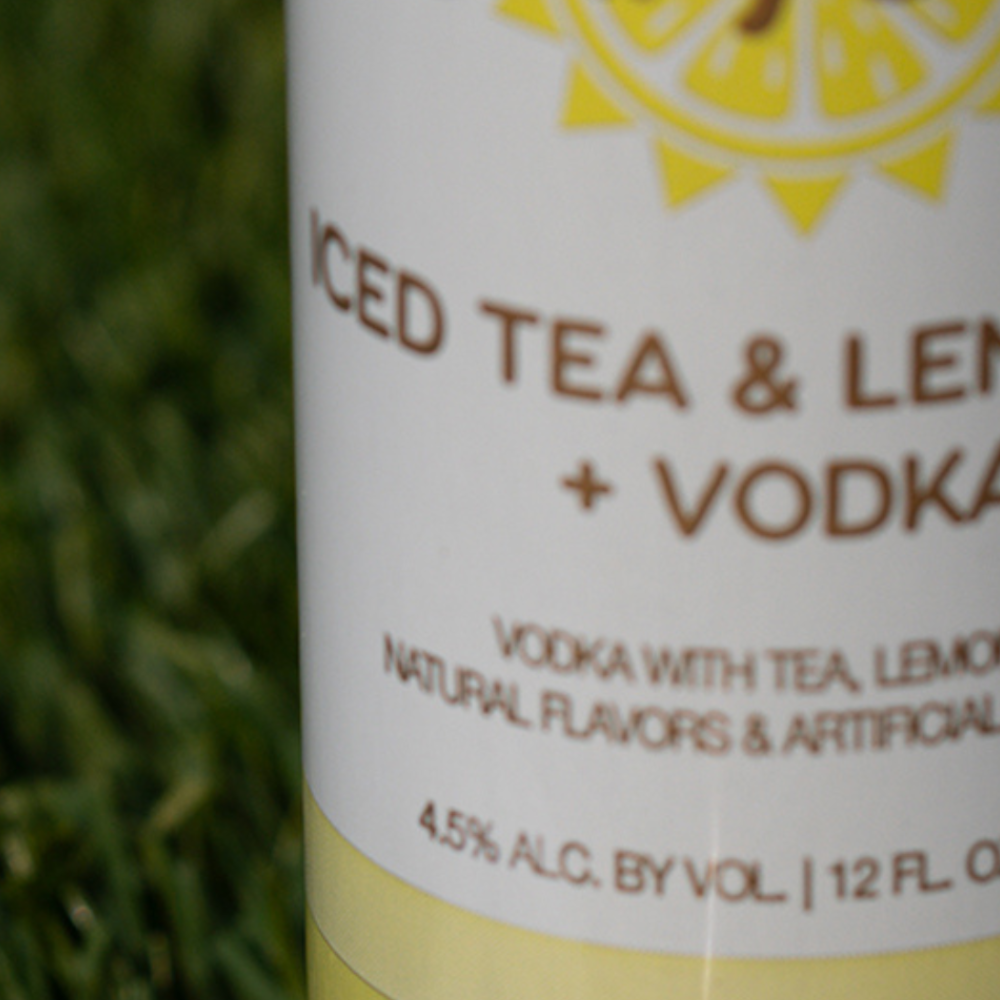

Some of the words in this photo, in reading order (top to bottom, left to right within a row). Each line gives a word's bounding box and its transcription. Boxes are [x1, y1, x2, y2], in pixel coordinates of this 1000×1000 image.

[310, 208, 446, 357] ICED
[478, 299, 690, 411] TEA
[731, 335, 798, 416] &
[561, 460, 612, 512] +
[383, 631, 533, 730] NATURAL
[540, 689, 732, 756] FLAVORS
[741, 711, 771, 756] &
[492, 614, 636, 685] VODKA
[641, 643, 755, 692] WITH
[418, 799, 500, 864] 4.5%
[508, 830, 602, 889] ALC.
[612, 848, 675, 896] BY
[829, 856, 881, 899] 12
